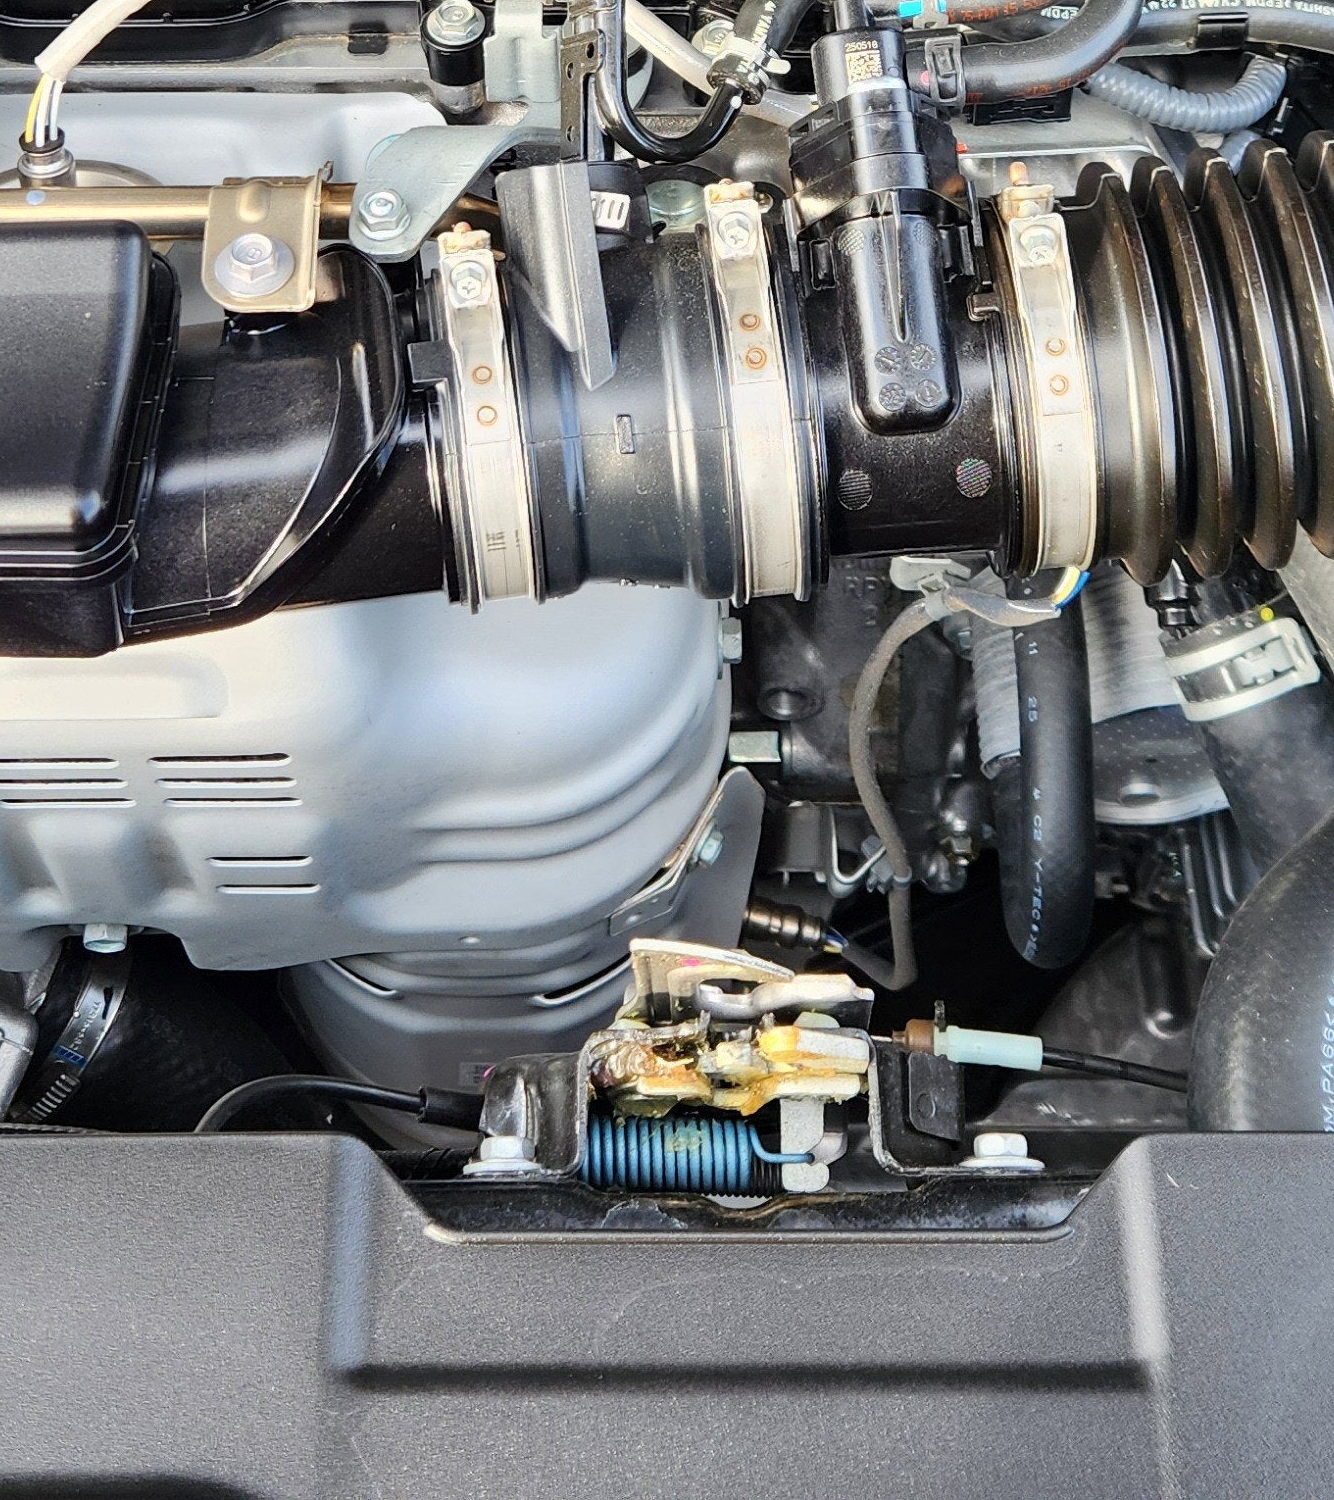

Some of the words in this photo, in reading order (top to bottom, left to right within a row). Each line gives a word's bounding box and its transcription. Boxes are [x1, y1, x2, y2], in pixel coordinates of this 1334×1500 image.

[1028, 641, 1039, 655] 11
[1033, 814, 1043, 841] C2
[1030, 857, 1043, 921] Y-TEC
